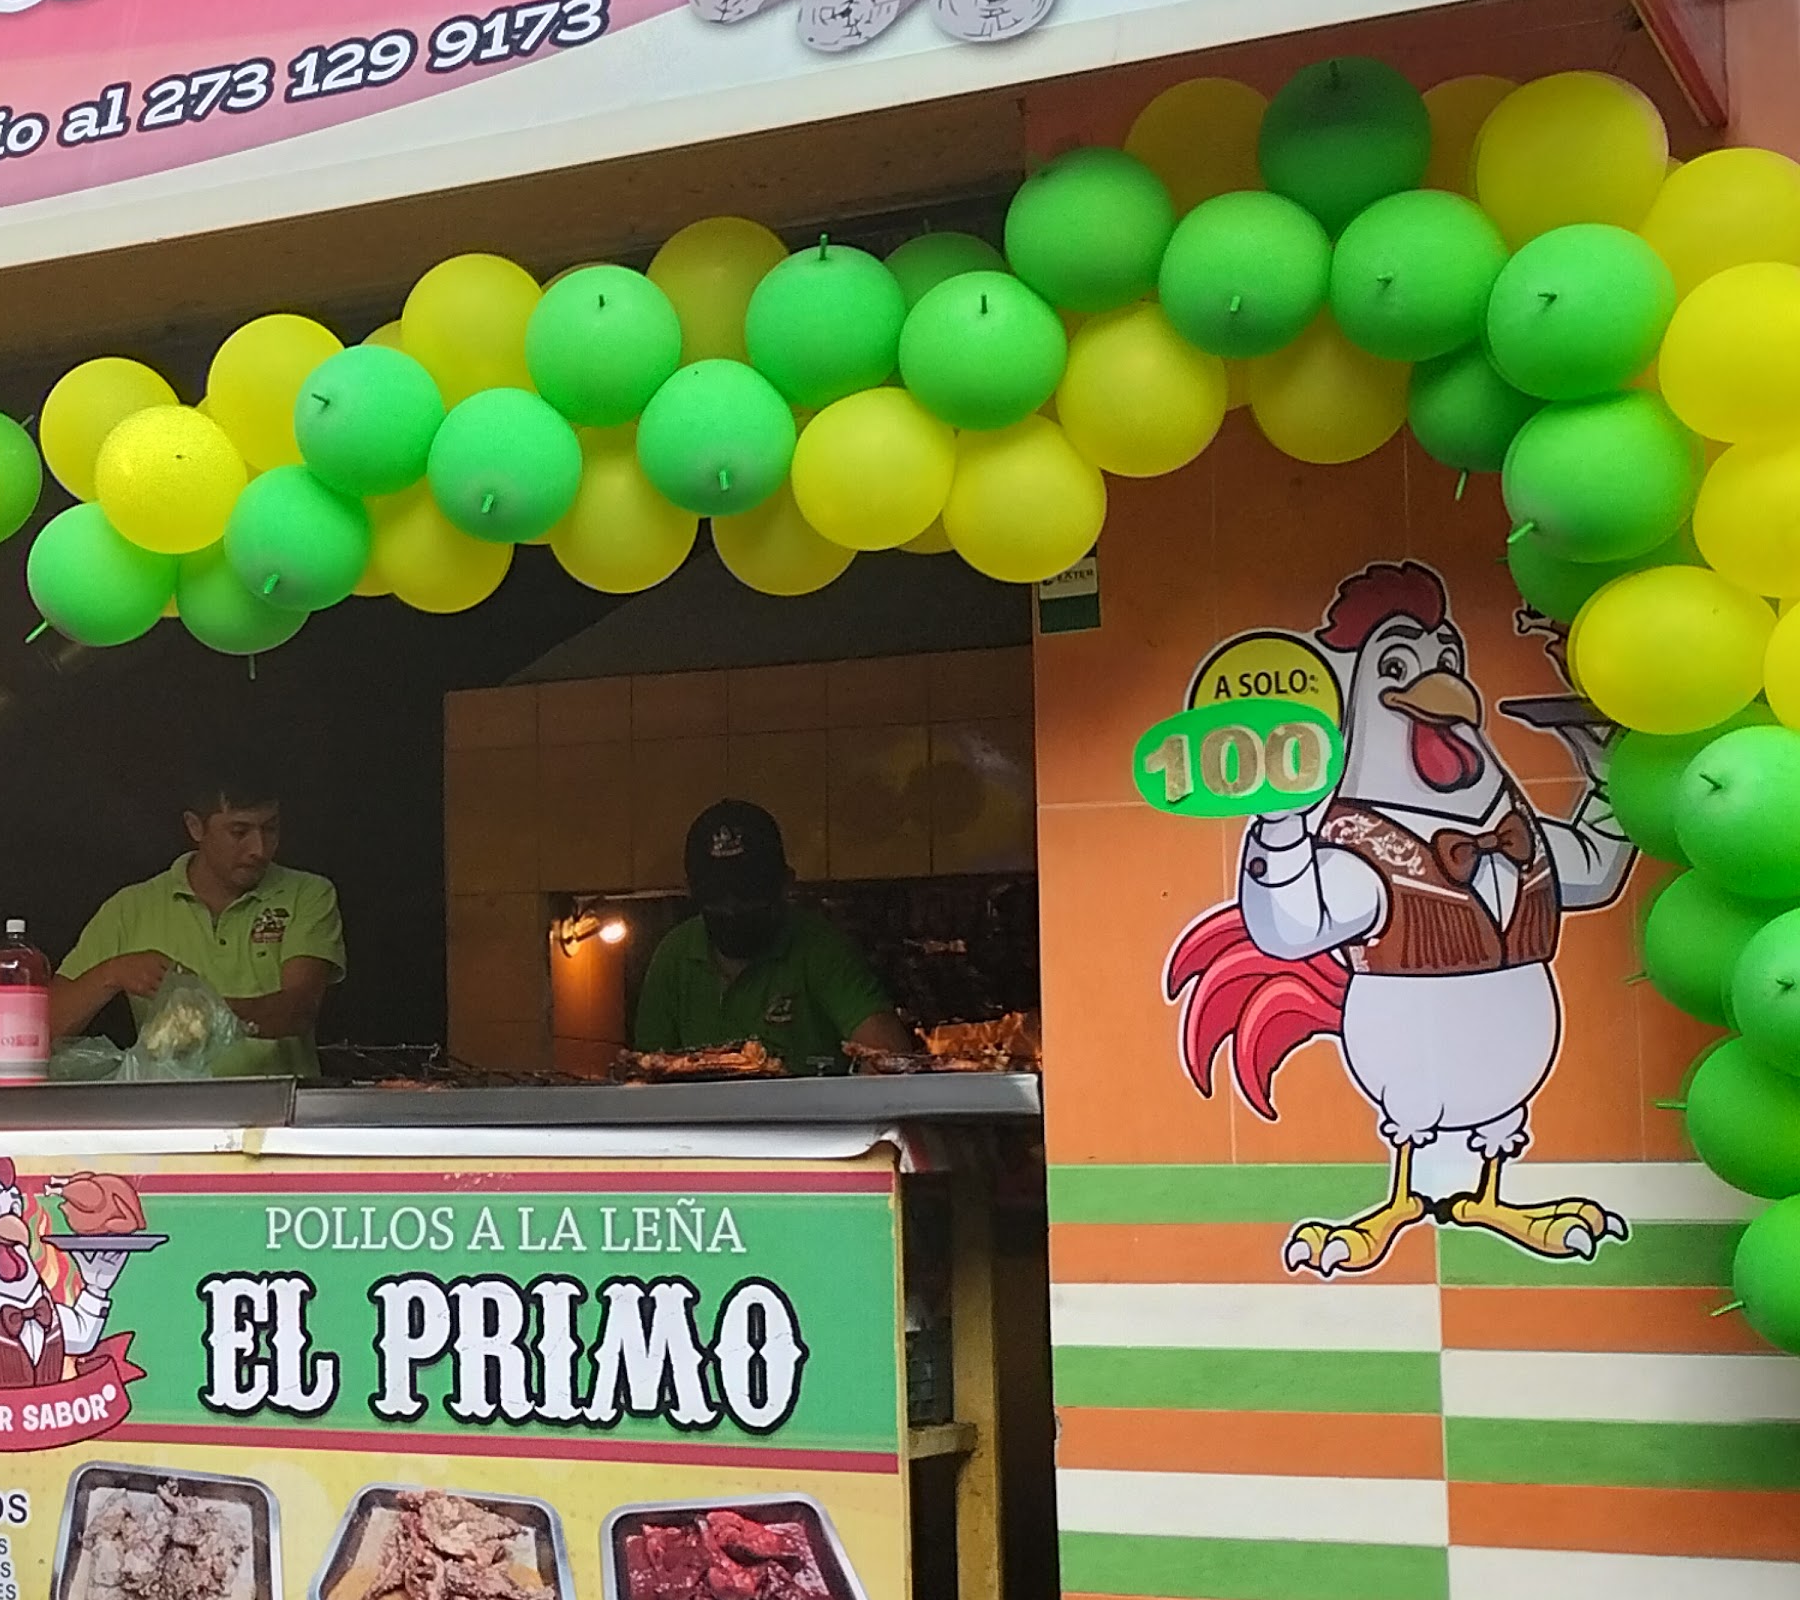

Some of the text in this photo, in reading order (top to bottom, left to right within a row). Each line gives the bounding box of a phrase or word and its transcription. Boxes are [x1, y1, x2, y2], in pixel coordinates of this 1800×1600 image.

[64, 89, 125, 144] al
[143, 61, 268, 128] 273
[292, 33, 411, 99] 129
[1215, 669, 1318, 699] A SOLO:
[1145, 722, 1332, 802] 100
[266, 1198, 747, 1255] POLLOS A LA LEÑA
[201, 1273, 808, 1432] EL PRIMO
[22, 1393, 108, 1431] SABOR
